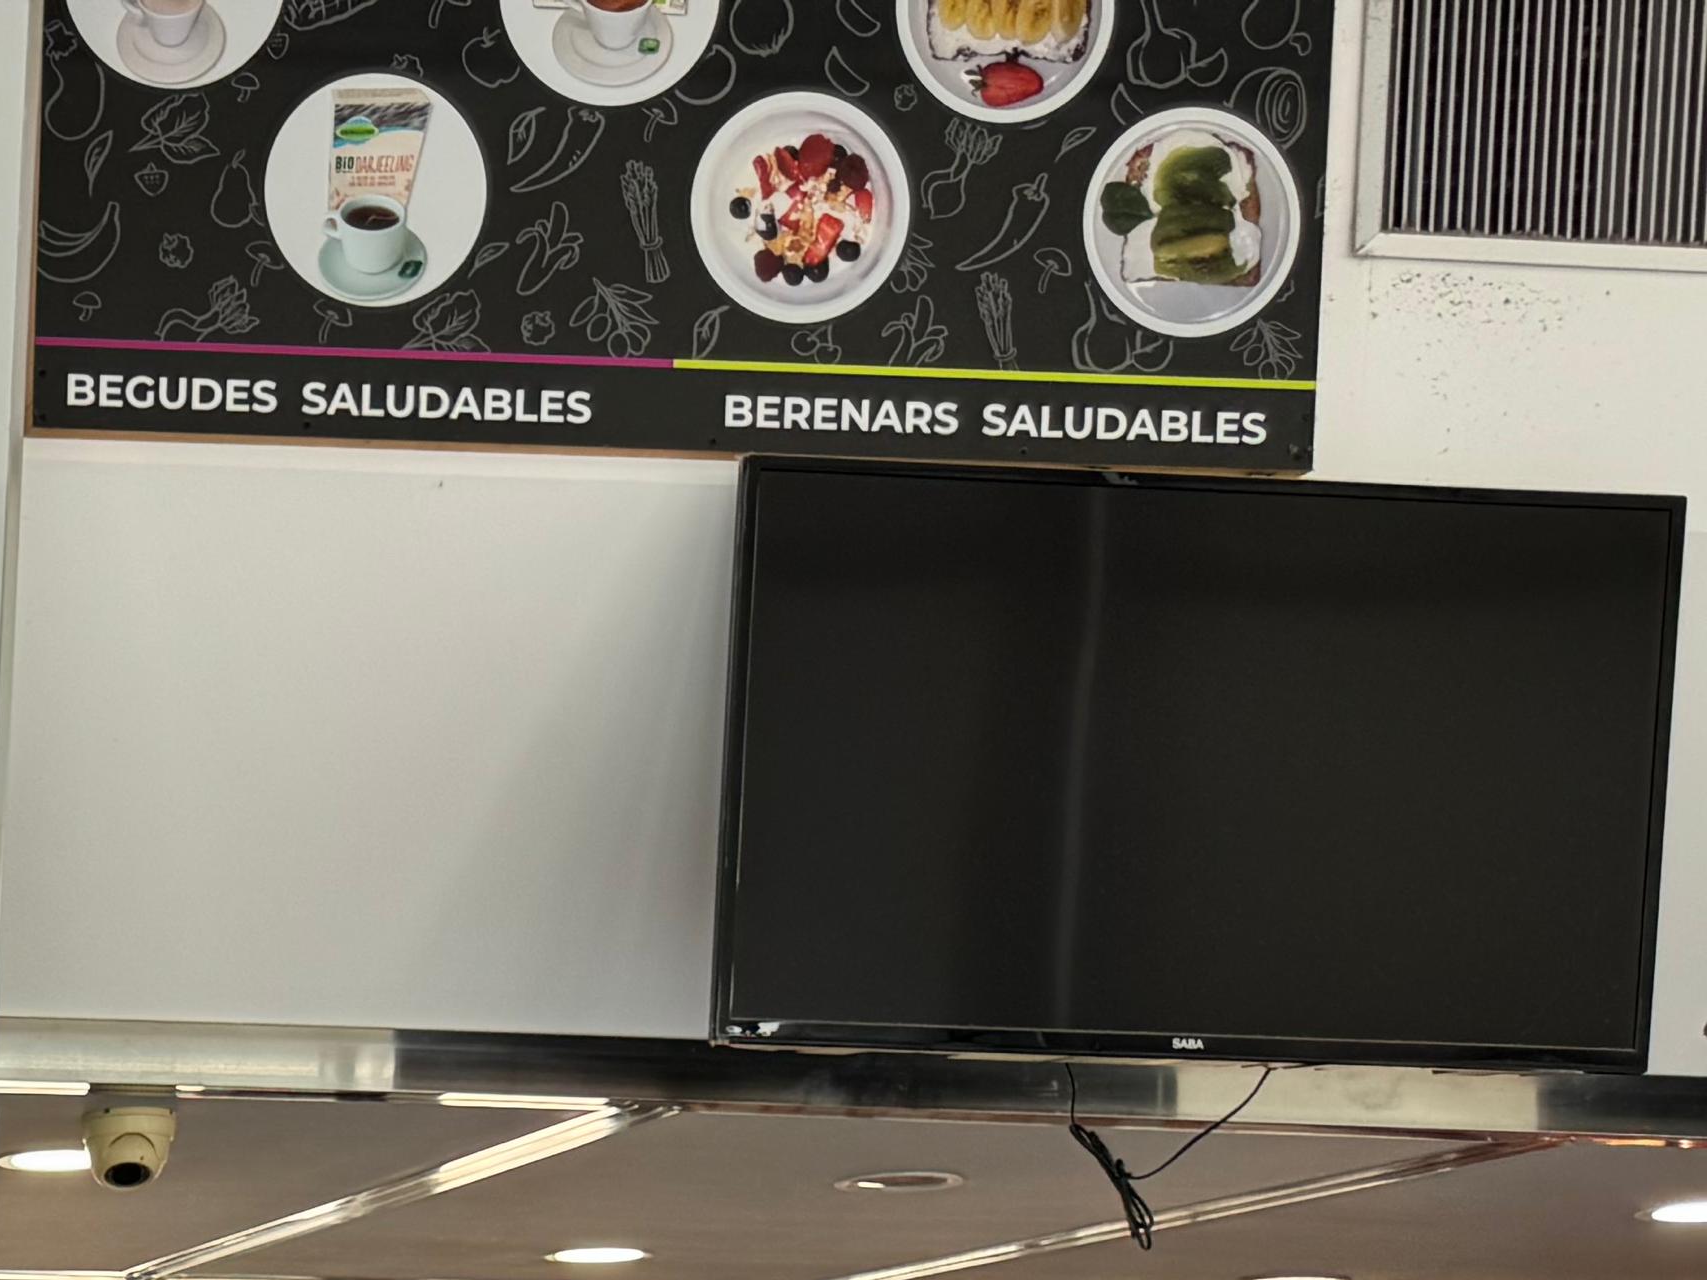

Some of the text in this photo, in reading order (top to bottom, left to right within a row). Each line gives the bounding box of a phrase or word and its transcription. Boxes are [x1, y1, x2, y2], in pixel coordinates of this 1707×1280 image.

[66, 372, 592, 425] BEGUDES SALUDABLES
[724, 394, 1268, 446] BERENARS SALUDABLES
[1172, 1037, 1204, 1050] SABA
